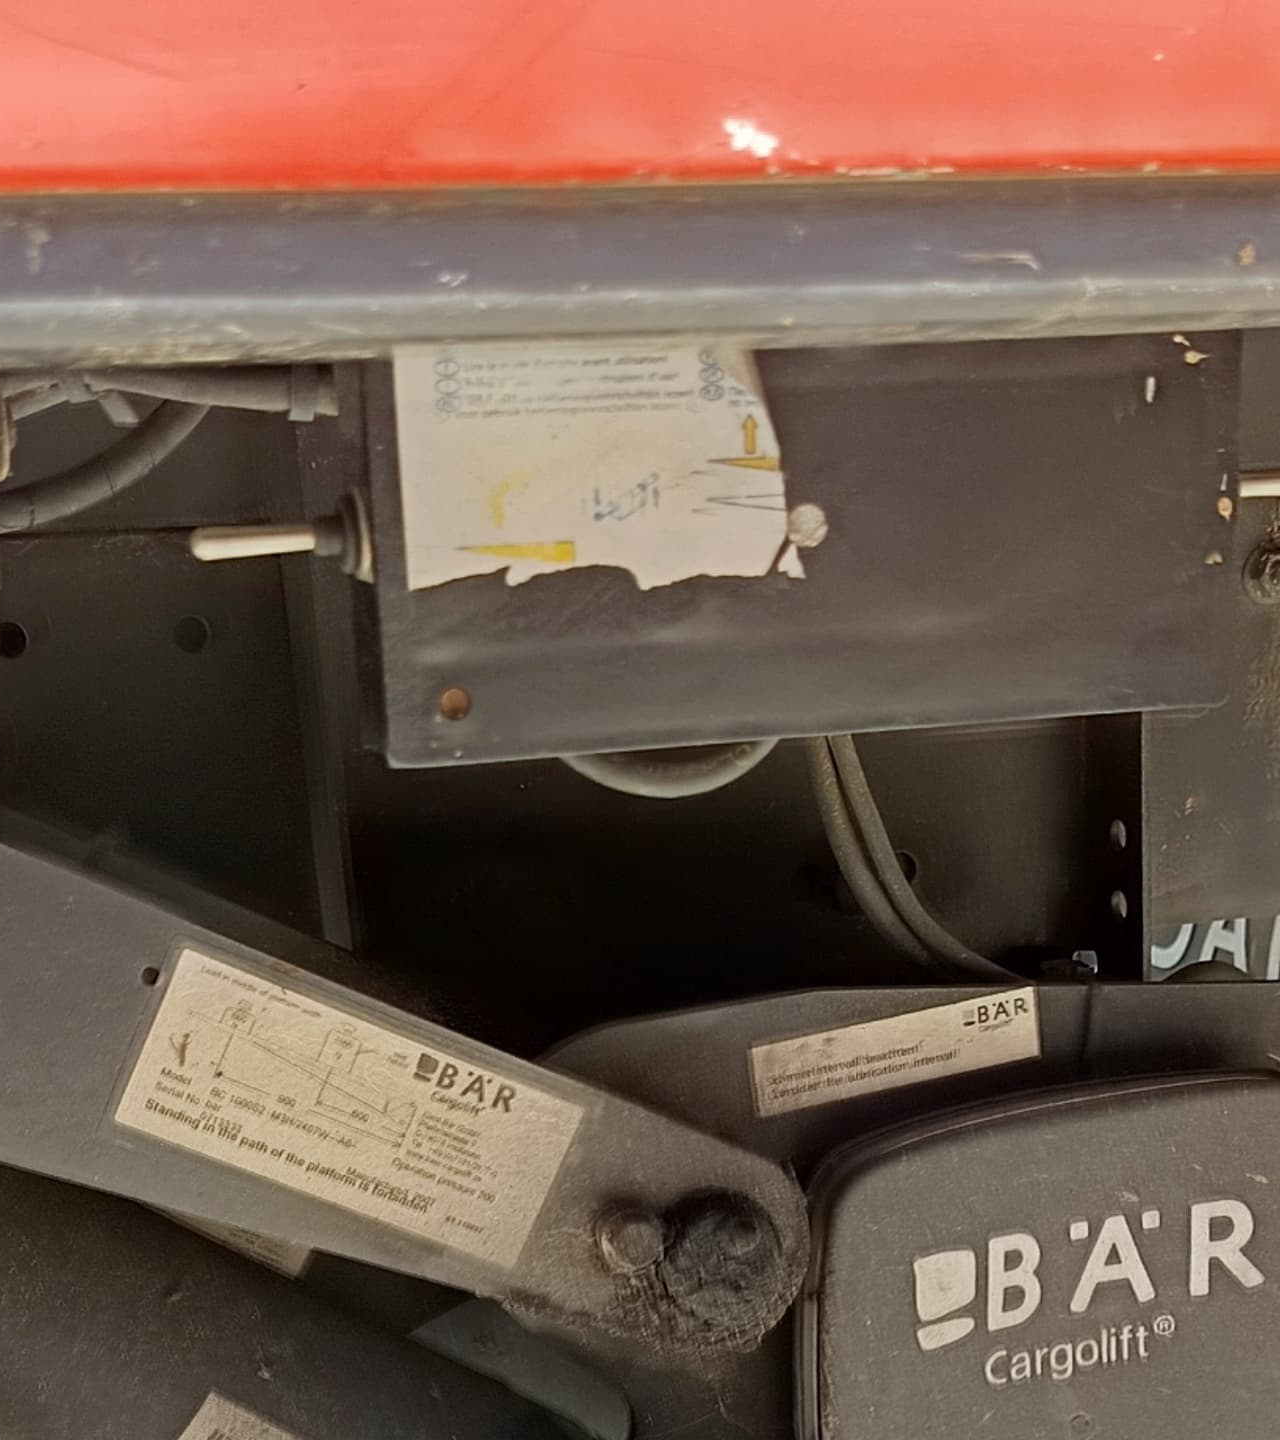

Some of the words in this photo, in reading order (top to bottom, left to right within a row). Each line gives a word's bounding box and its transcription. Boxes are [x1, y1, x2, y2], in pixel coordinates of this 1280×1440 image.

[978, 998, 1029, 1024] BÄR
[155, 1080, 184, 1098] Serial
[161, 1067, 192, 1085] Model
[435, 1062, 517, 1113] BÄR
[144, 1098, 201, 1129] Standing
[203, 1120, 216, 1133] in
[218, 1126, 239, 1142] the
[238, 1134, 268, 1157] path
[270, 1146, 284, 1159] of
[285, 1152, 306, 1168] the
[306, 1160, 357, 1189] platform
[359, 1181, 370, 1191] is
[371, 1184, 428, 1214] forbidden
[987, 1199, 1265, 1333] BÄR
